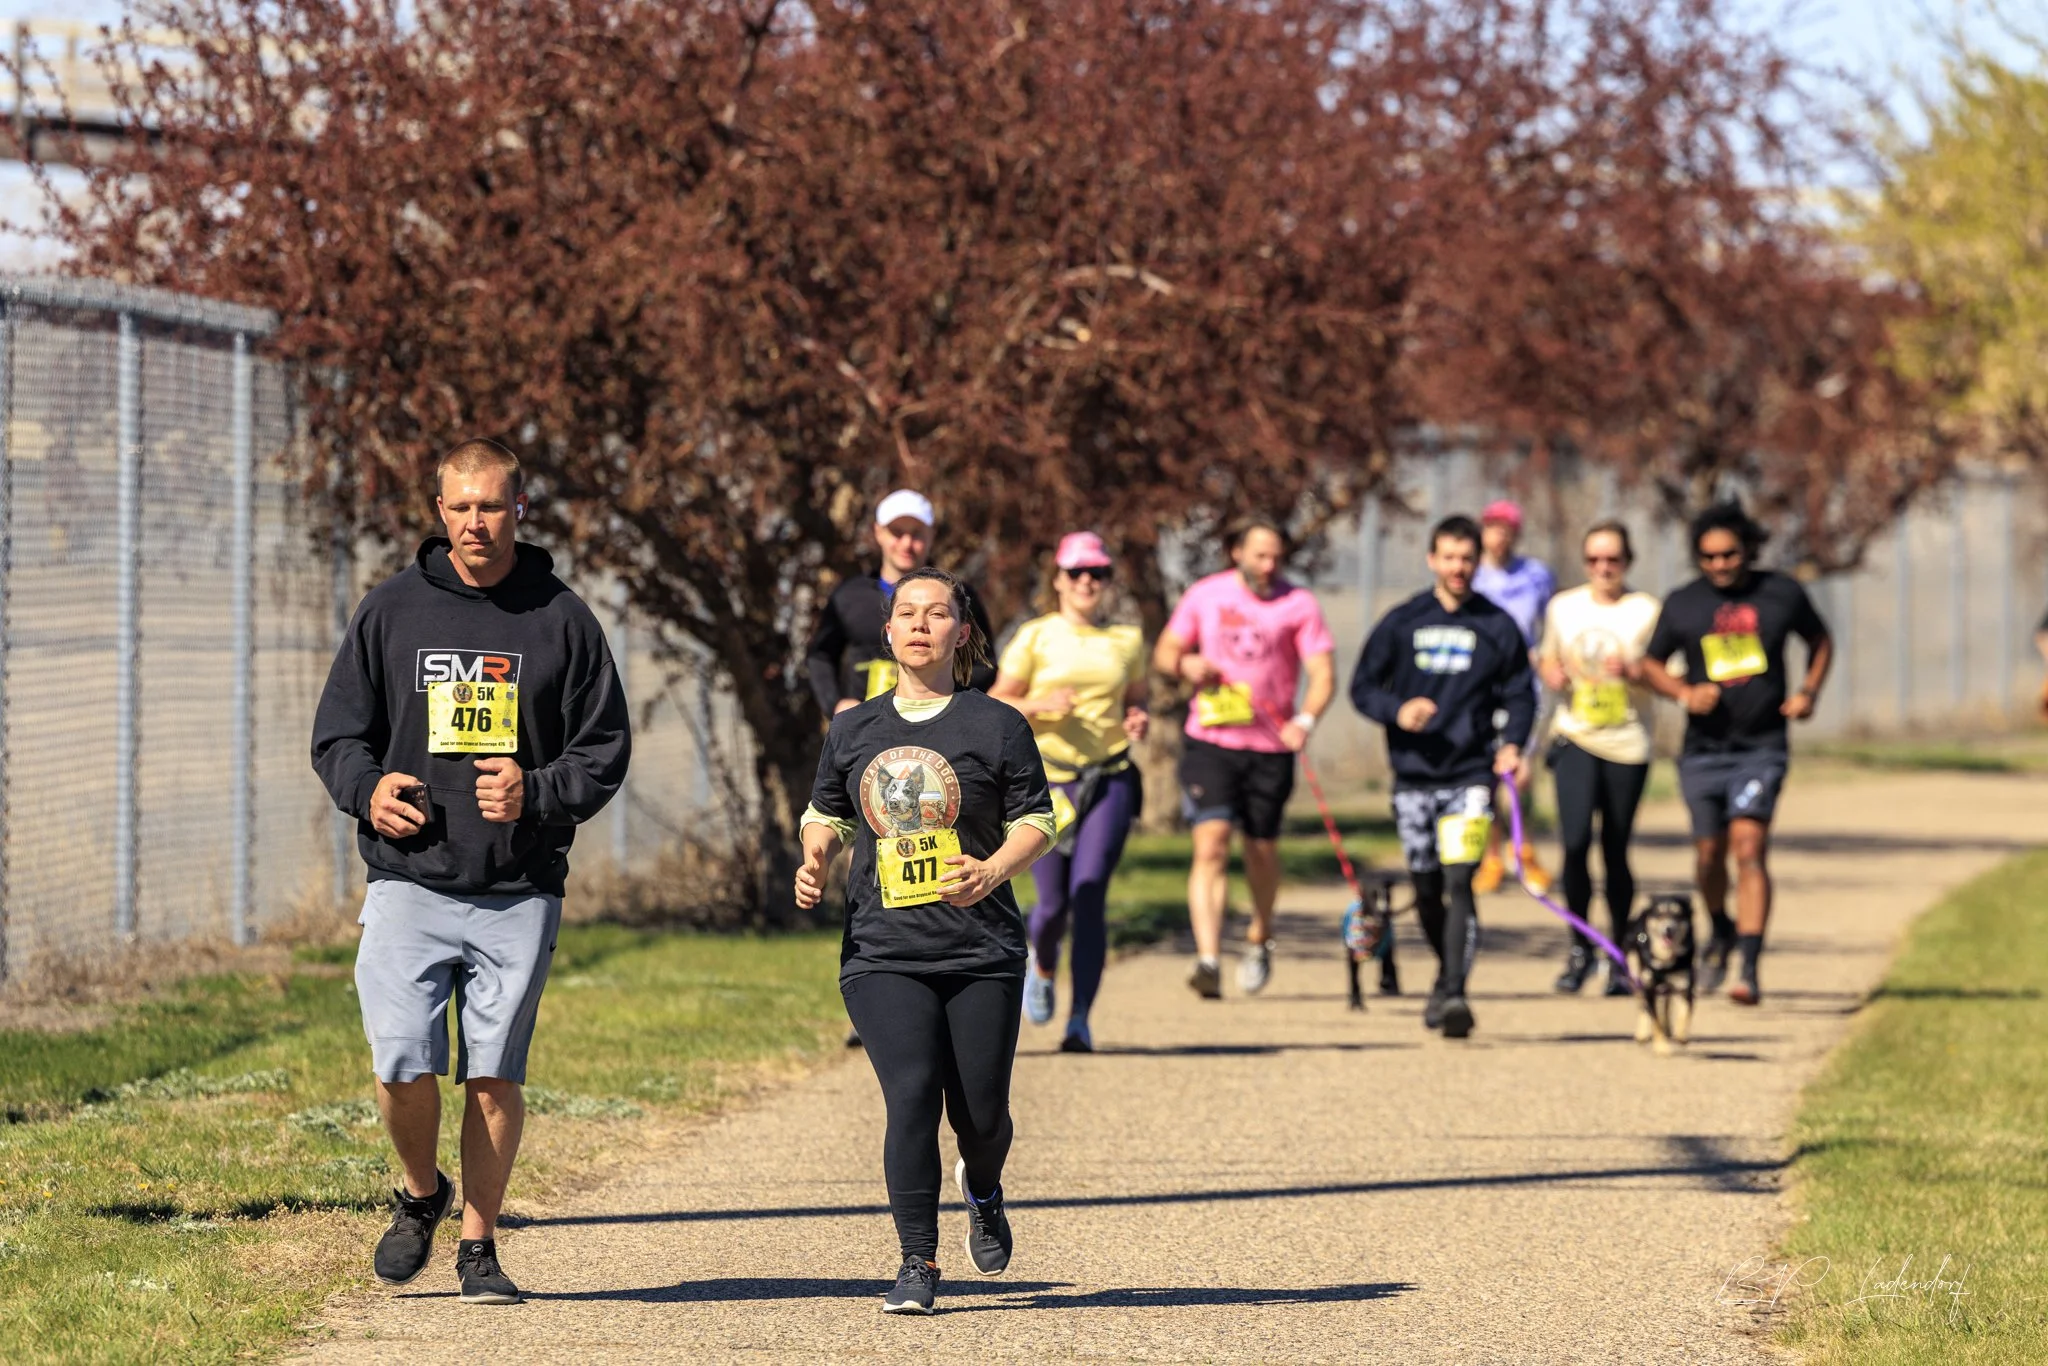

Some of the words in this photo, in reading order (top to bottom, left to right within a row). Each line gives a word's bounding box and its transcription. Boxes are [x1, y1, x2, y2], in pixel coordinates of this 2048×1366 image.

[423, 654, 511, 683] SMR
[477, 687, 495, 701] 5K
[451, 707, 492, 732] 476
[863, 758, 886, 785] HAIR
[889, 749, 905, 760] OF
[911, 749, 935, 762] THE
[934, 760, 956, 785] DOG
[919, 835, 939, 852] 5K
[902, 856, 938, 885] 477
